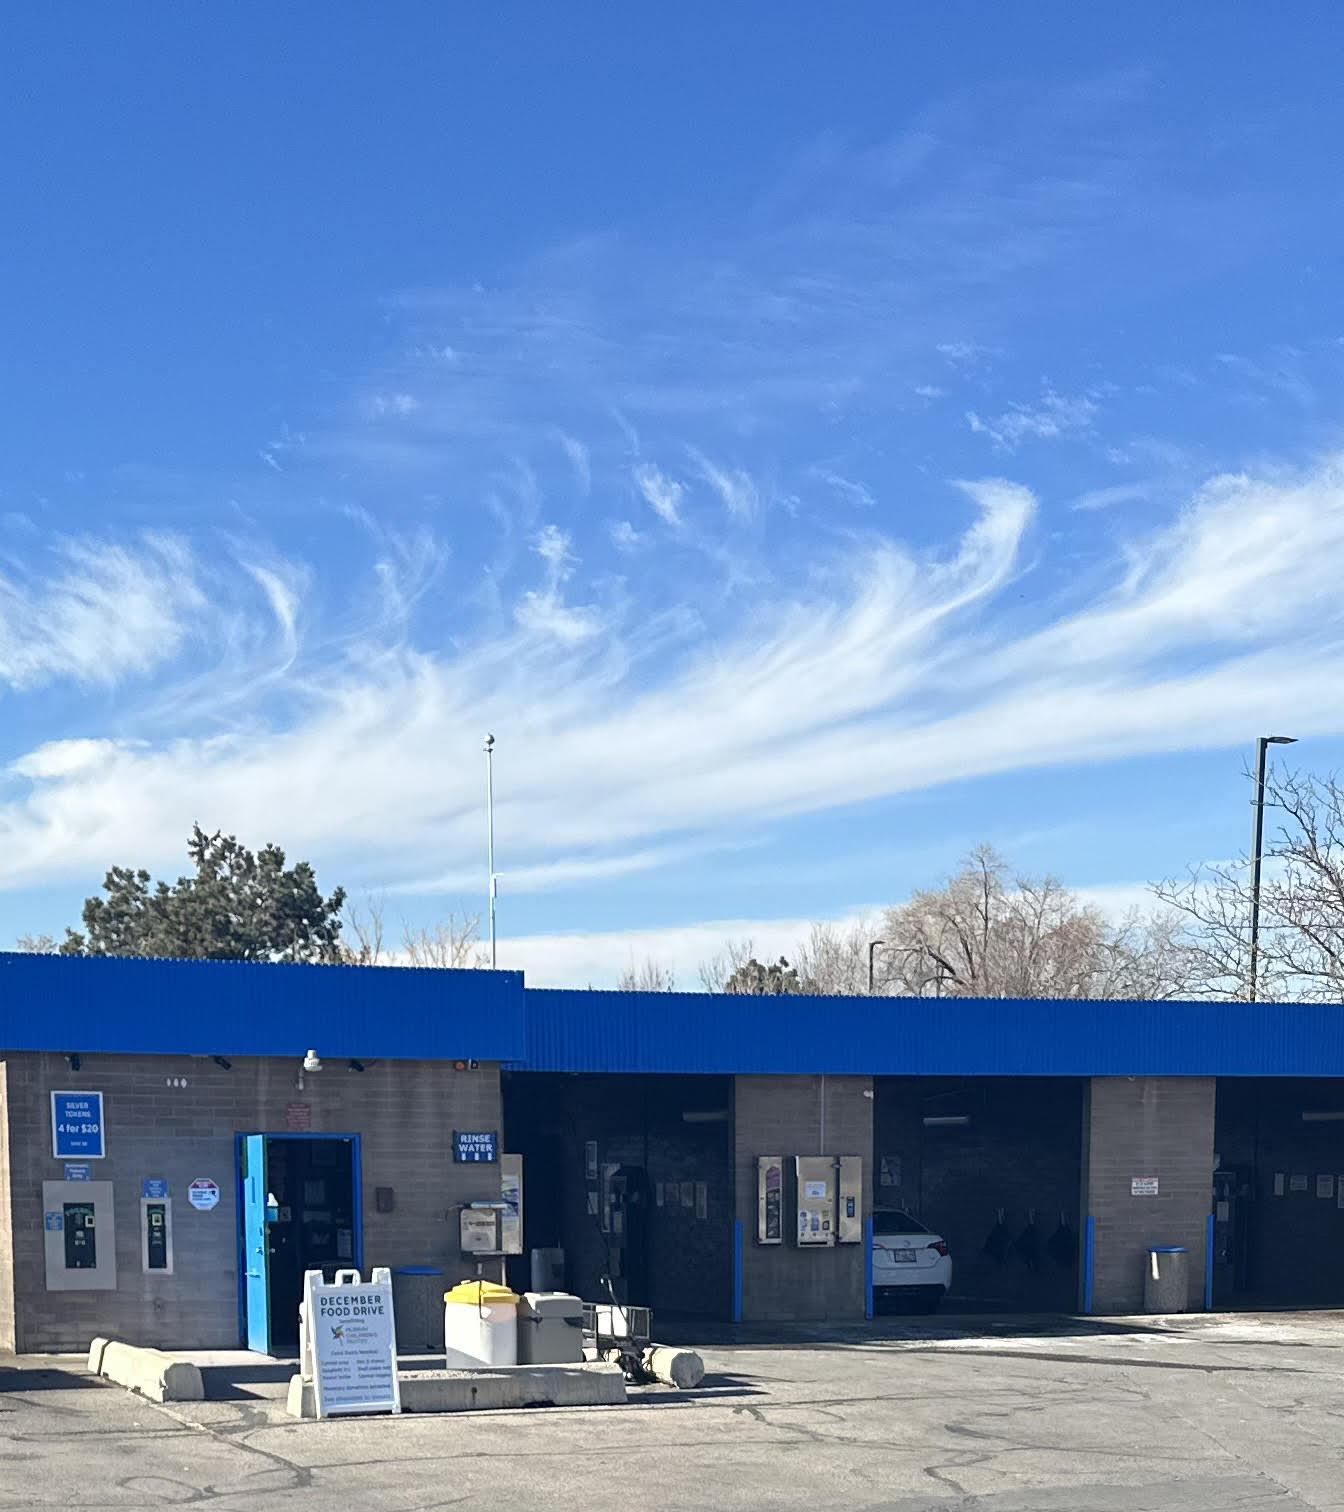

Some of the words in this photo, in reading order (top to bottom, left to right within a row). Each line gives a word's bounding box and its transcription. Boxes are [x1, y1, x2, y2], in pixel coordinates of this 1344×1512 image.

[58, 1125, 65, 1133] 4
[66, 1124, 80, 1133] for
[81, 1124, 99, 1133] $20
[460, 1134, 491, 1143] RINSE
[458, 1143, 493, 1152] WATER
[320, 1295, 382, 1306] DECEMBER
[320, 1307, 351, 1317] FOOD
[353, 1306, 385, 1316] DRIVE
